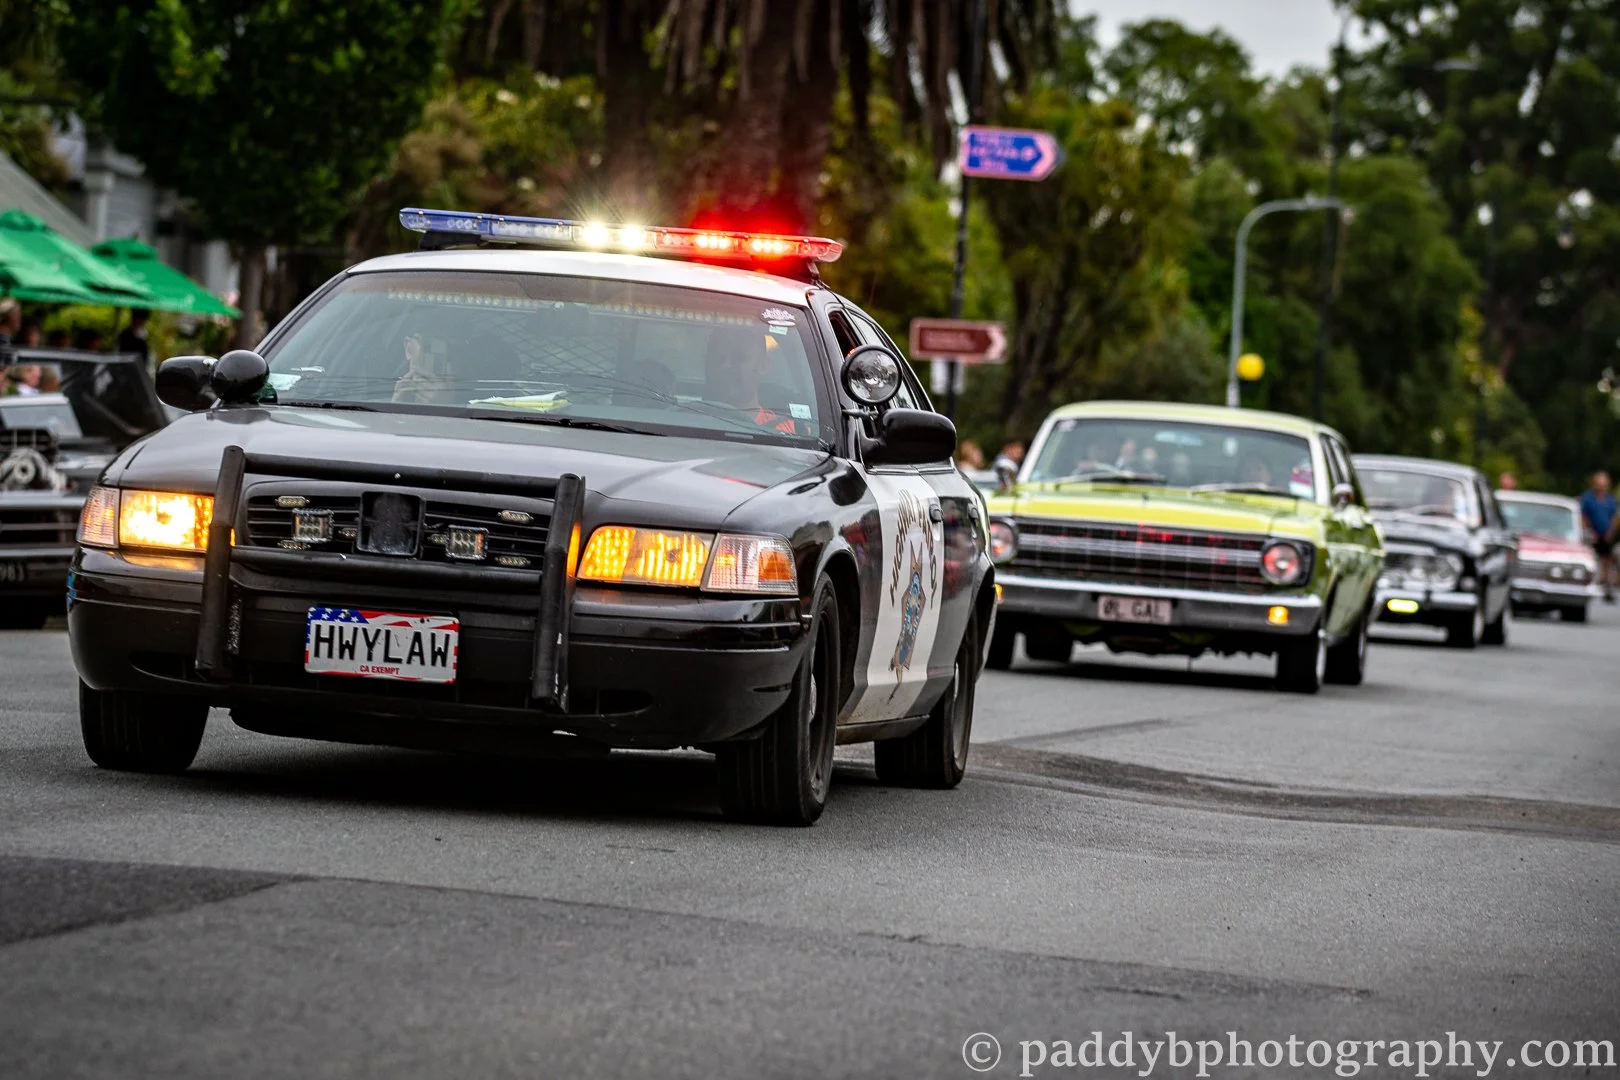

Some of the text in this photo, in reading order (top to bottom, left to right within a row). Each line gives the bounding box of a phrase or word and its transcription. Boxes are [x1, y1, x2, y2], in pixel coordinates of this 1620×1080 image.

[889, 488, 938, 609] HIGHWAY PATROL
[313, 623, 451, 668] HWYLAW
[359, 664, 400, 675] CA EXEMPT
